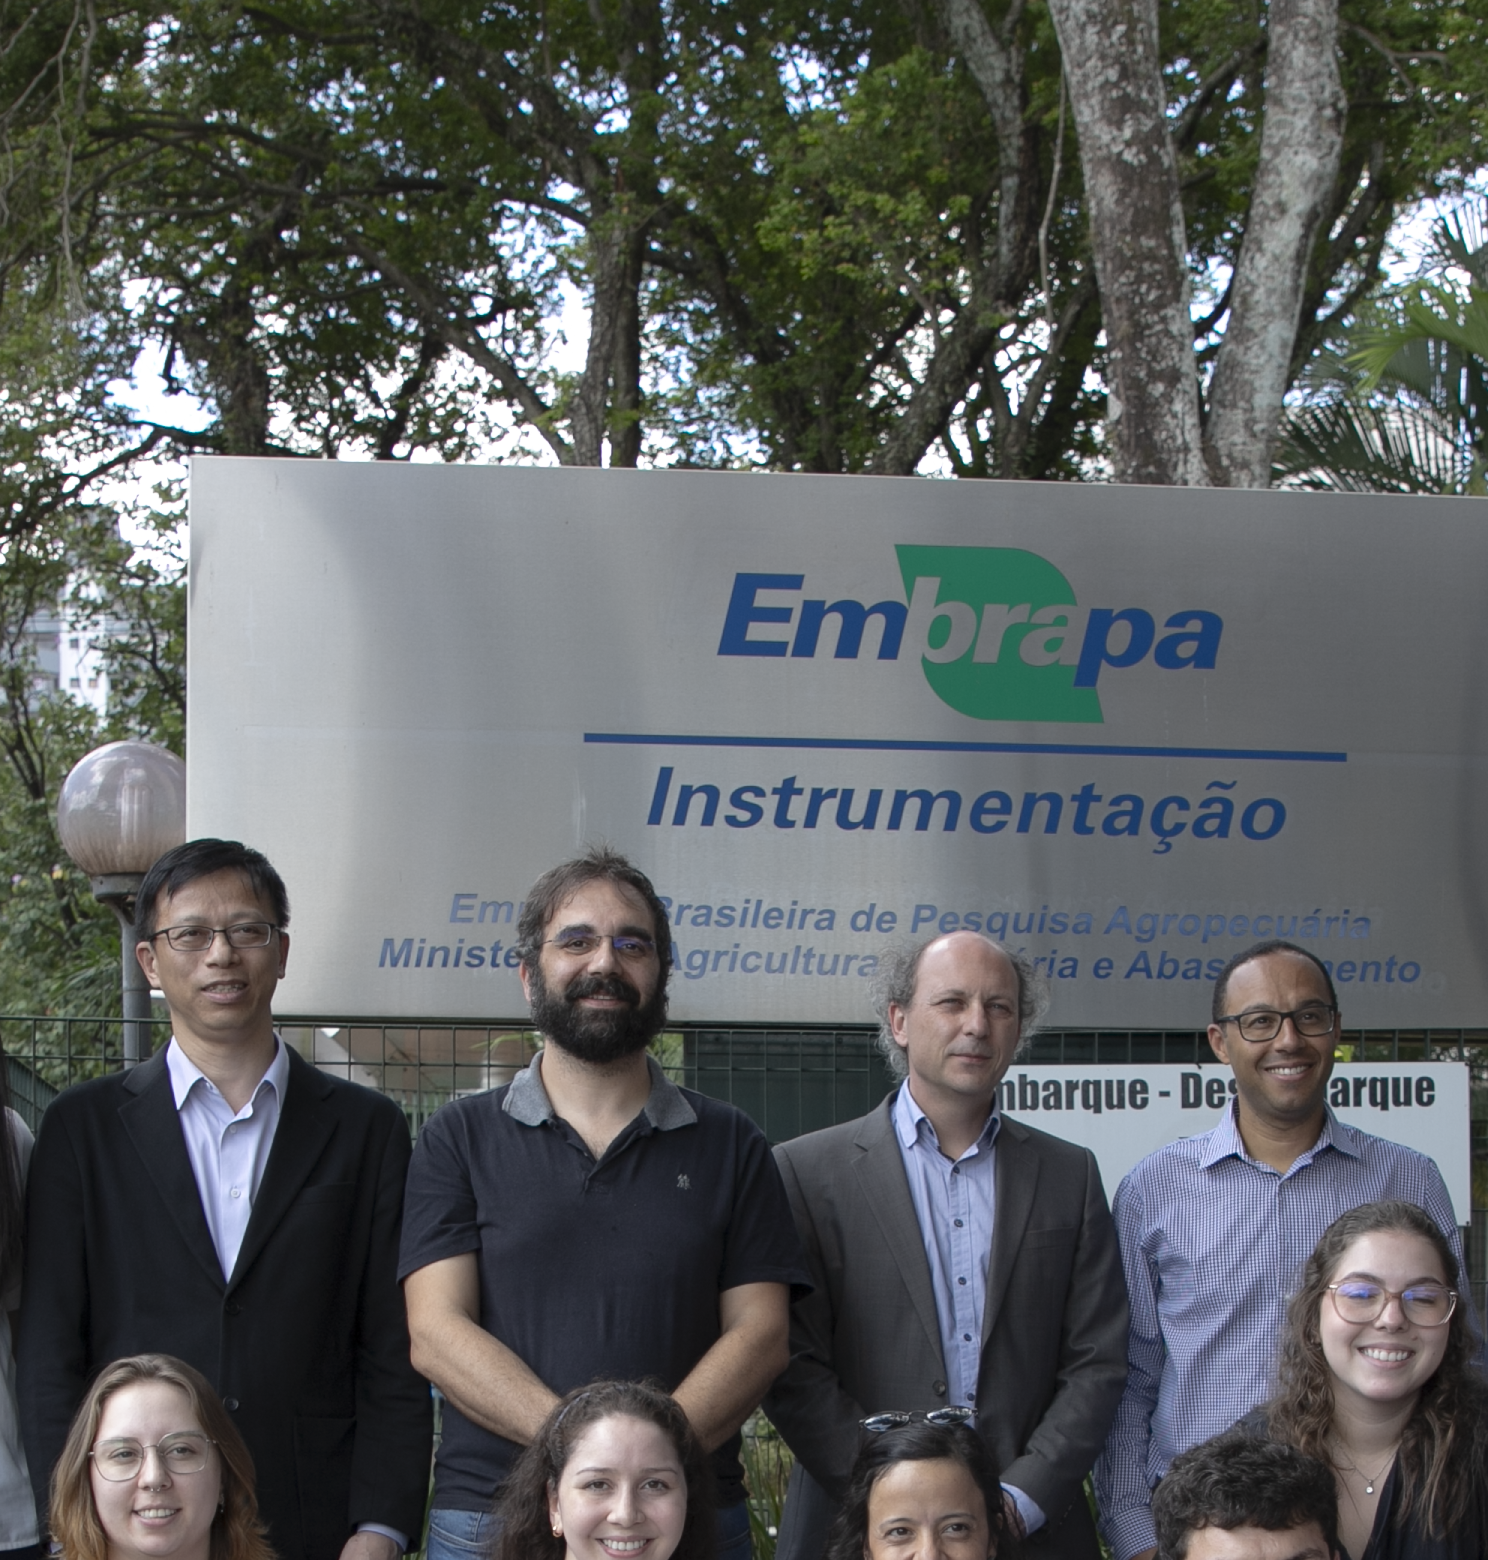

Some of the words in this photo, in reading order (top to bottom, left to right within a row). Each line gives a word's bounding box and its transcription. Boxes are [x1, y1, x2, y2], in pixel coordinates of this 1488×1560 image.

[717, 572, 1224, 689] Embrapa
[647, 766, 1287, 855] Instrumentação
[850, 903, 897, 933] de
[911, 904, 1093, 942] Pesquisa
[1103, 905, 1372, 943] Agropecuária
[1092, 957, 1113, 979] e
